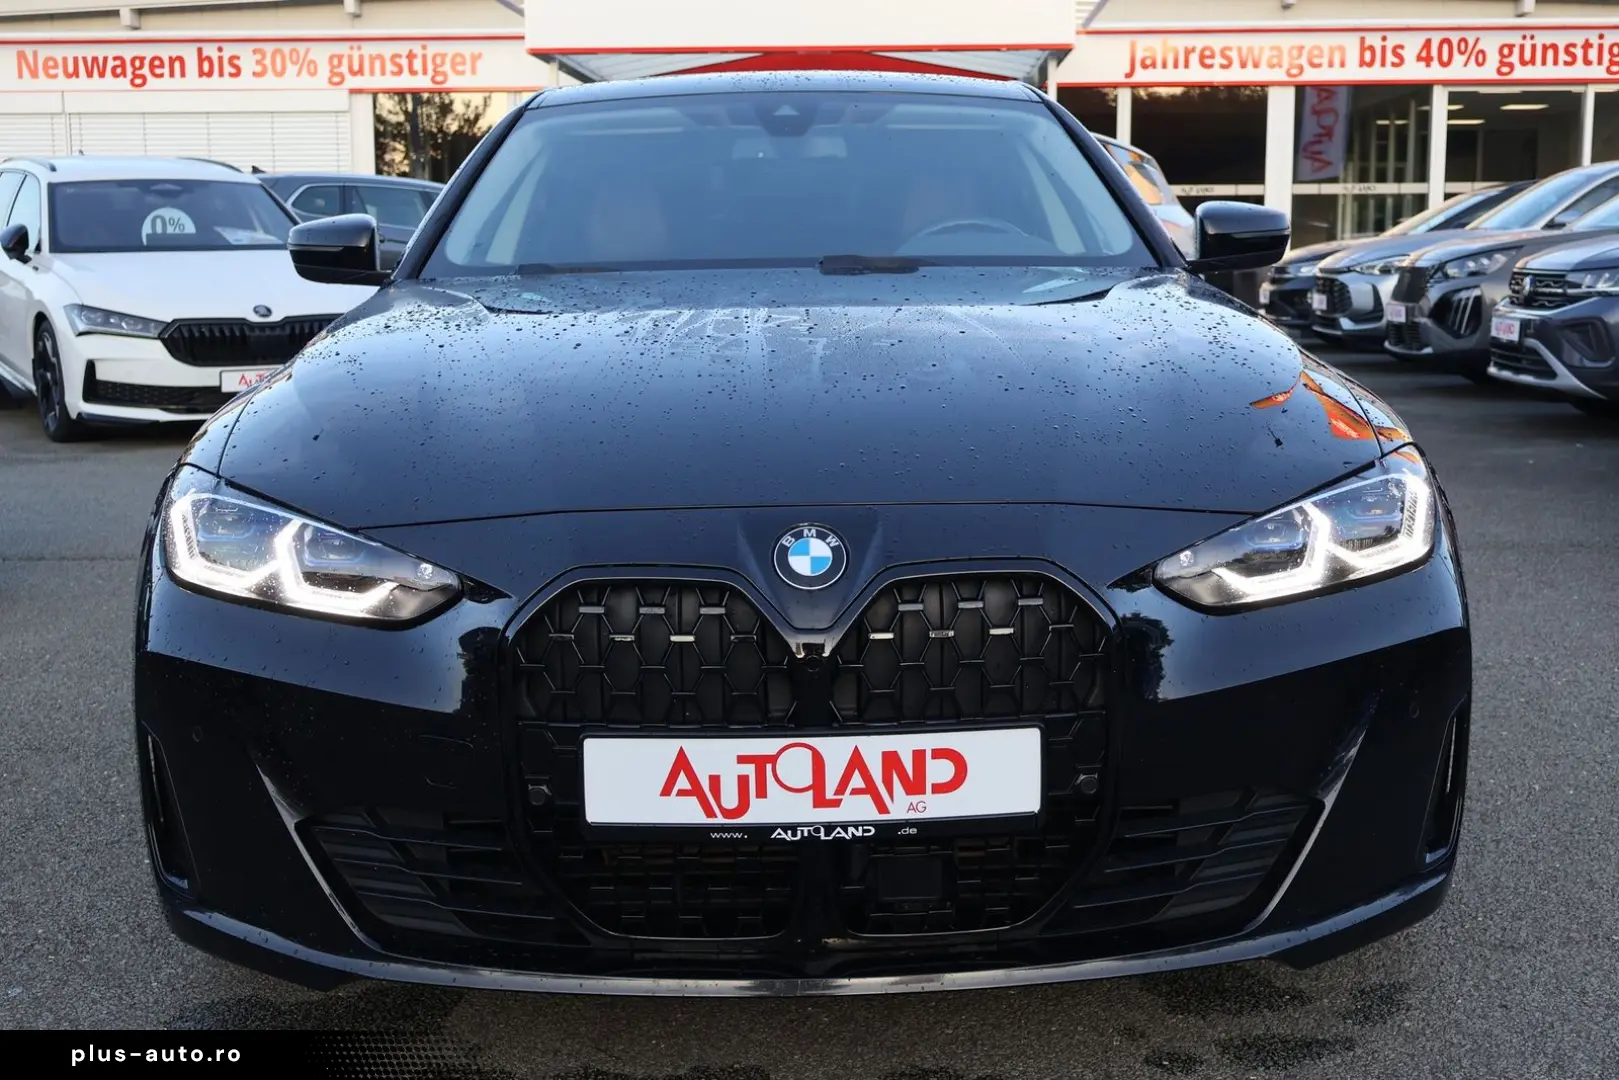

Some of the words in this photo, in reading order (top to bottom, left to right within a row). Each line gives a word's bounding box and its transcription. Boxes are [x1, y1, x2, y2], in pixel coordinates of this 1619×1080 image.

[15, 49, 187, 89] Neuwagen
[196, 46, 242, 79] bis
[251, 47, 319, 79] 30%
[327, 44, 483, 86] günstiger
[1124, 38, 1347, 79] Jahreswagen
[1358, 35, 1405, 68] bis
[1415, 37, 1487, 69] 40%
[781, 528, 840, 548] BMW
[659, 742, 968, 820] AUTOLAND
[906, 800, 927, 814] AG
[710, 831, 748, 839] www.
[897, 826, 918, 835] .de
